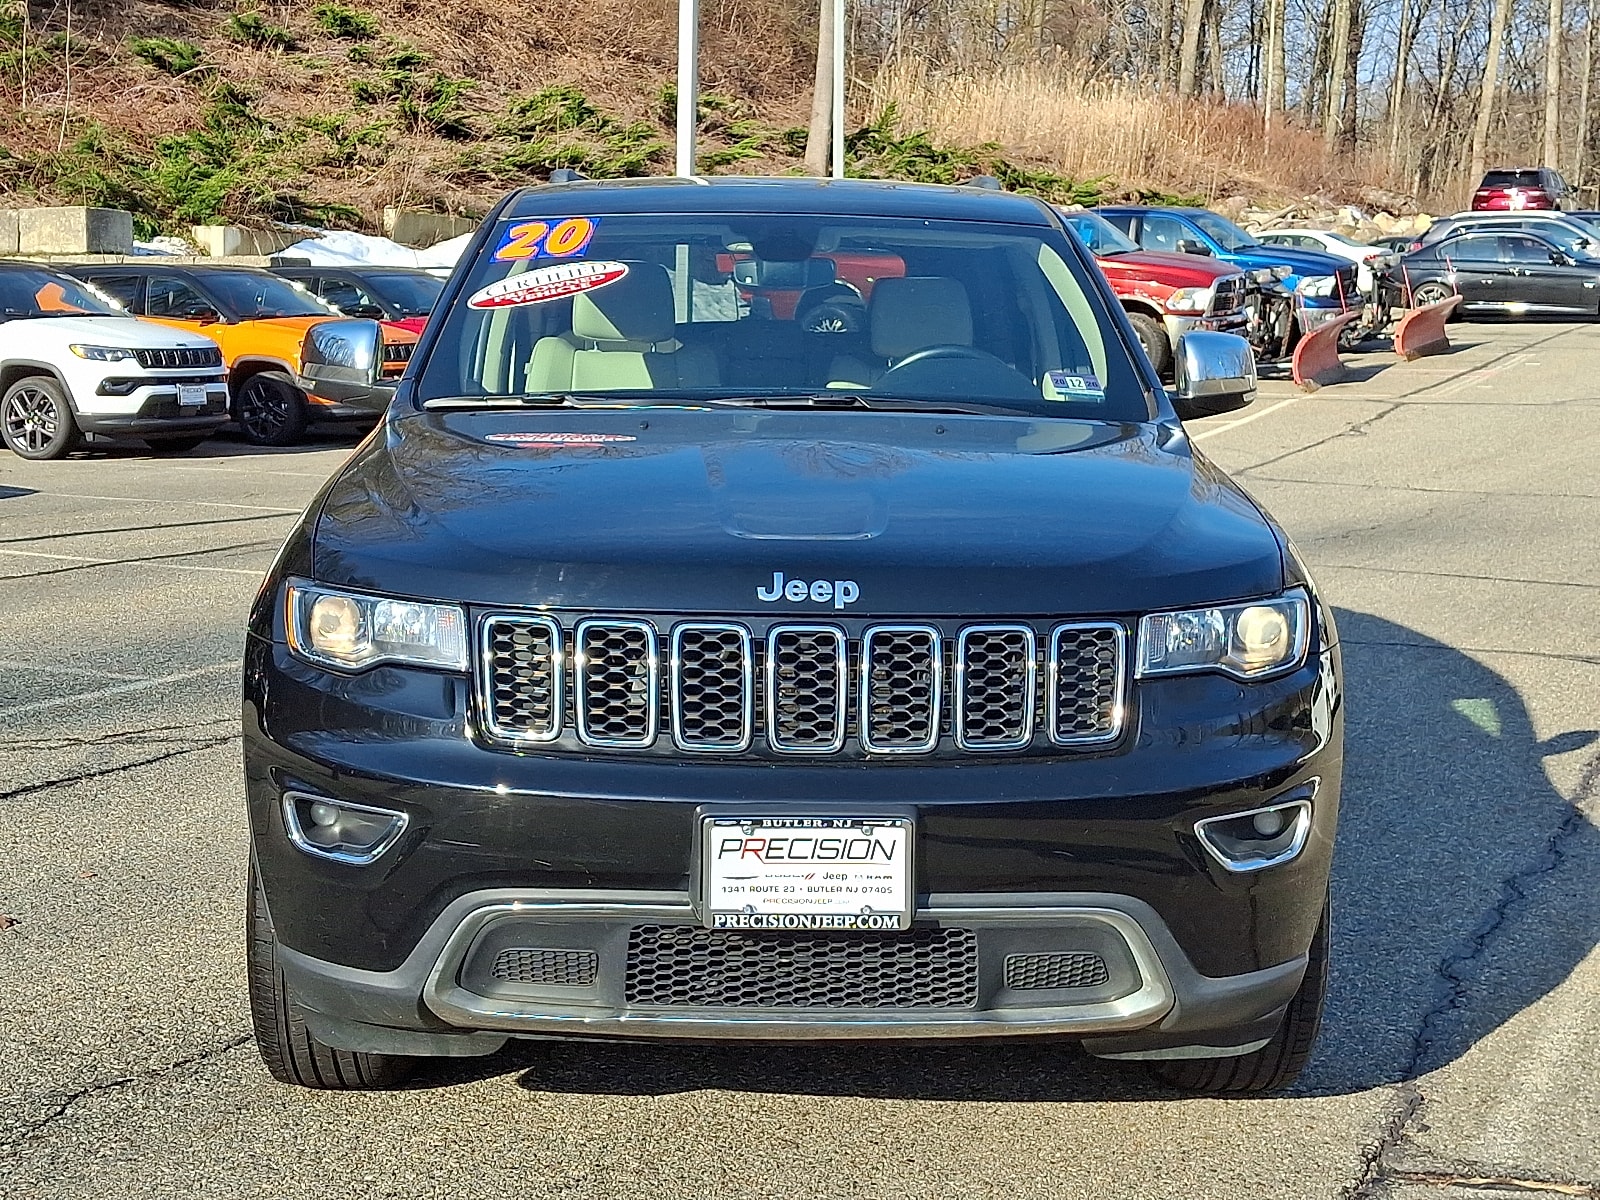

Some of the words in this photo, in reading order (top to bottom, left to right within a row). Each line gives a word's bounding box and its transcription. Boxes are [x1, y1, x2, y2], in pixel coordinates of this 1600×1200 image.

[495, 217, 593, 261] 20
[1069, 379, 1083, 387] 12
[757, 572, 860, 609] Jeep
[762, 819, 828, 828] BUTLER,
[833, 819, 852, 828] NJ
[718, 838, 896, 860] PRECISION
[823, 872, 848, 881] Jeep
[862, 886, 893, 894] 07405
[713, 915, 899, 929] PRECISIONJEEP.COM
